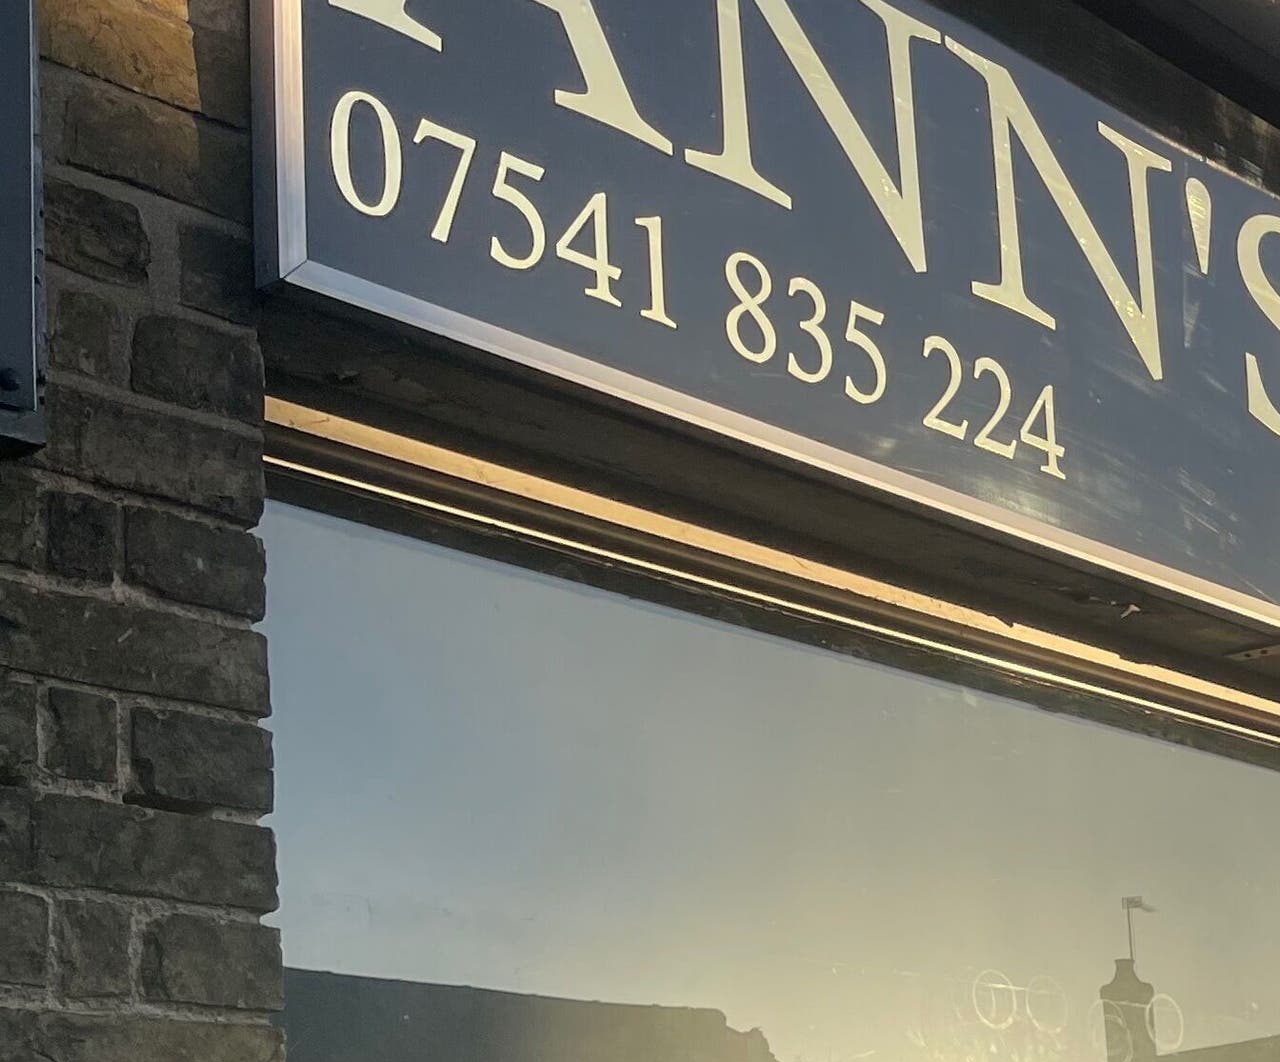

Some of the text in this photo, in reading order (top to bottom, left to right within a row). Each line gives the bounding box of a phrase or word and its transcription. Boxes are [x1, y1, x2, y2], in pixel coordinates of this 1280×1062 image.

[330, 90, 1066, 480] 07541 835 224
